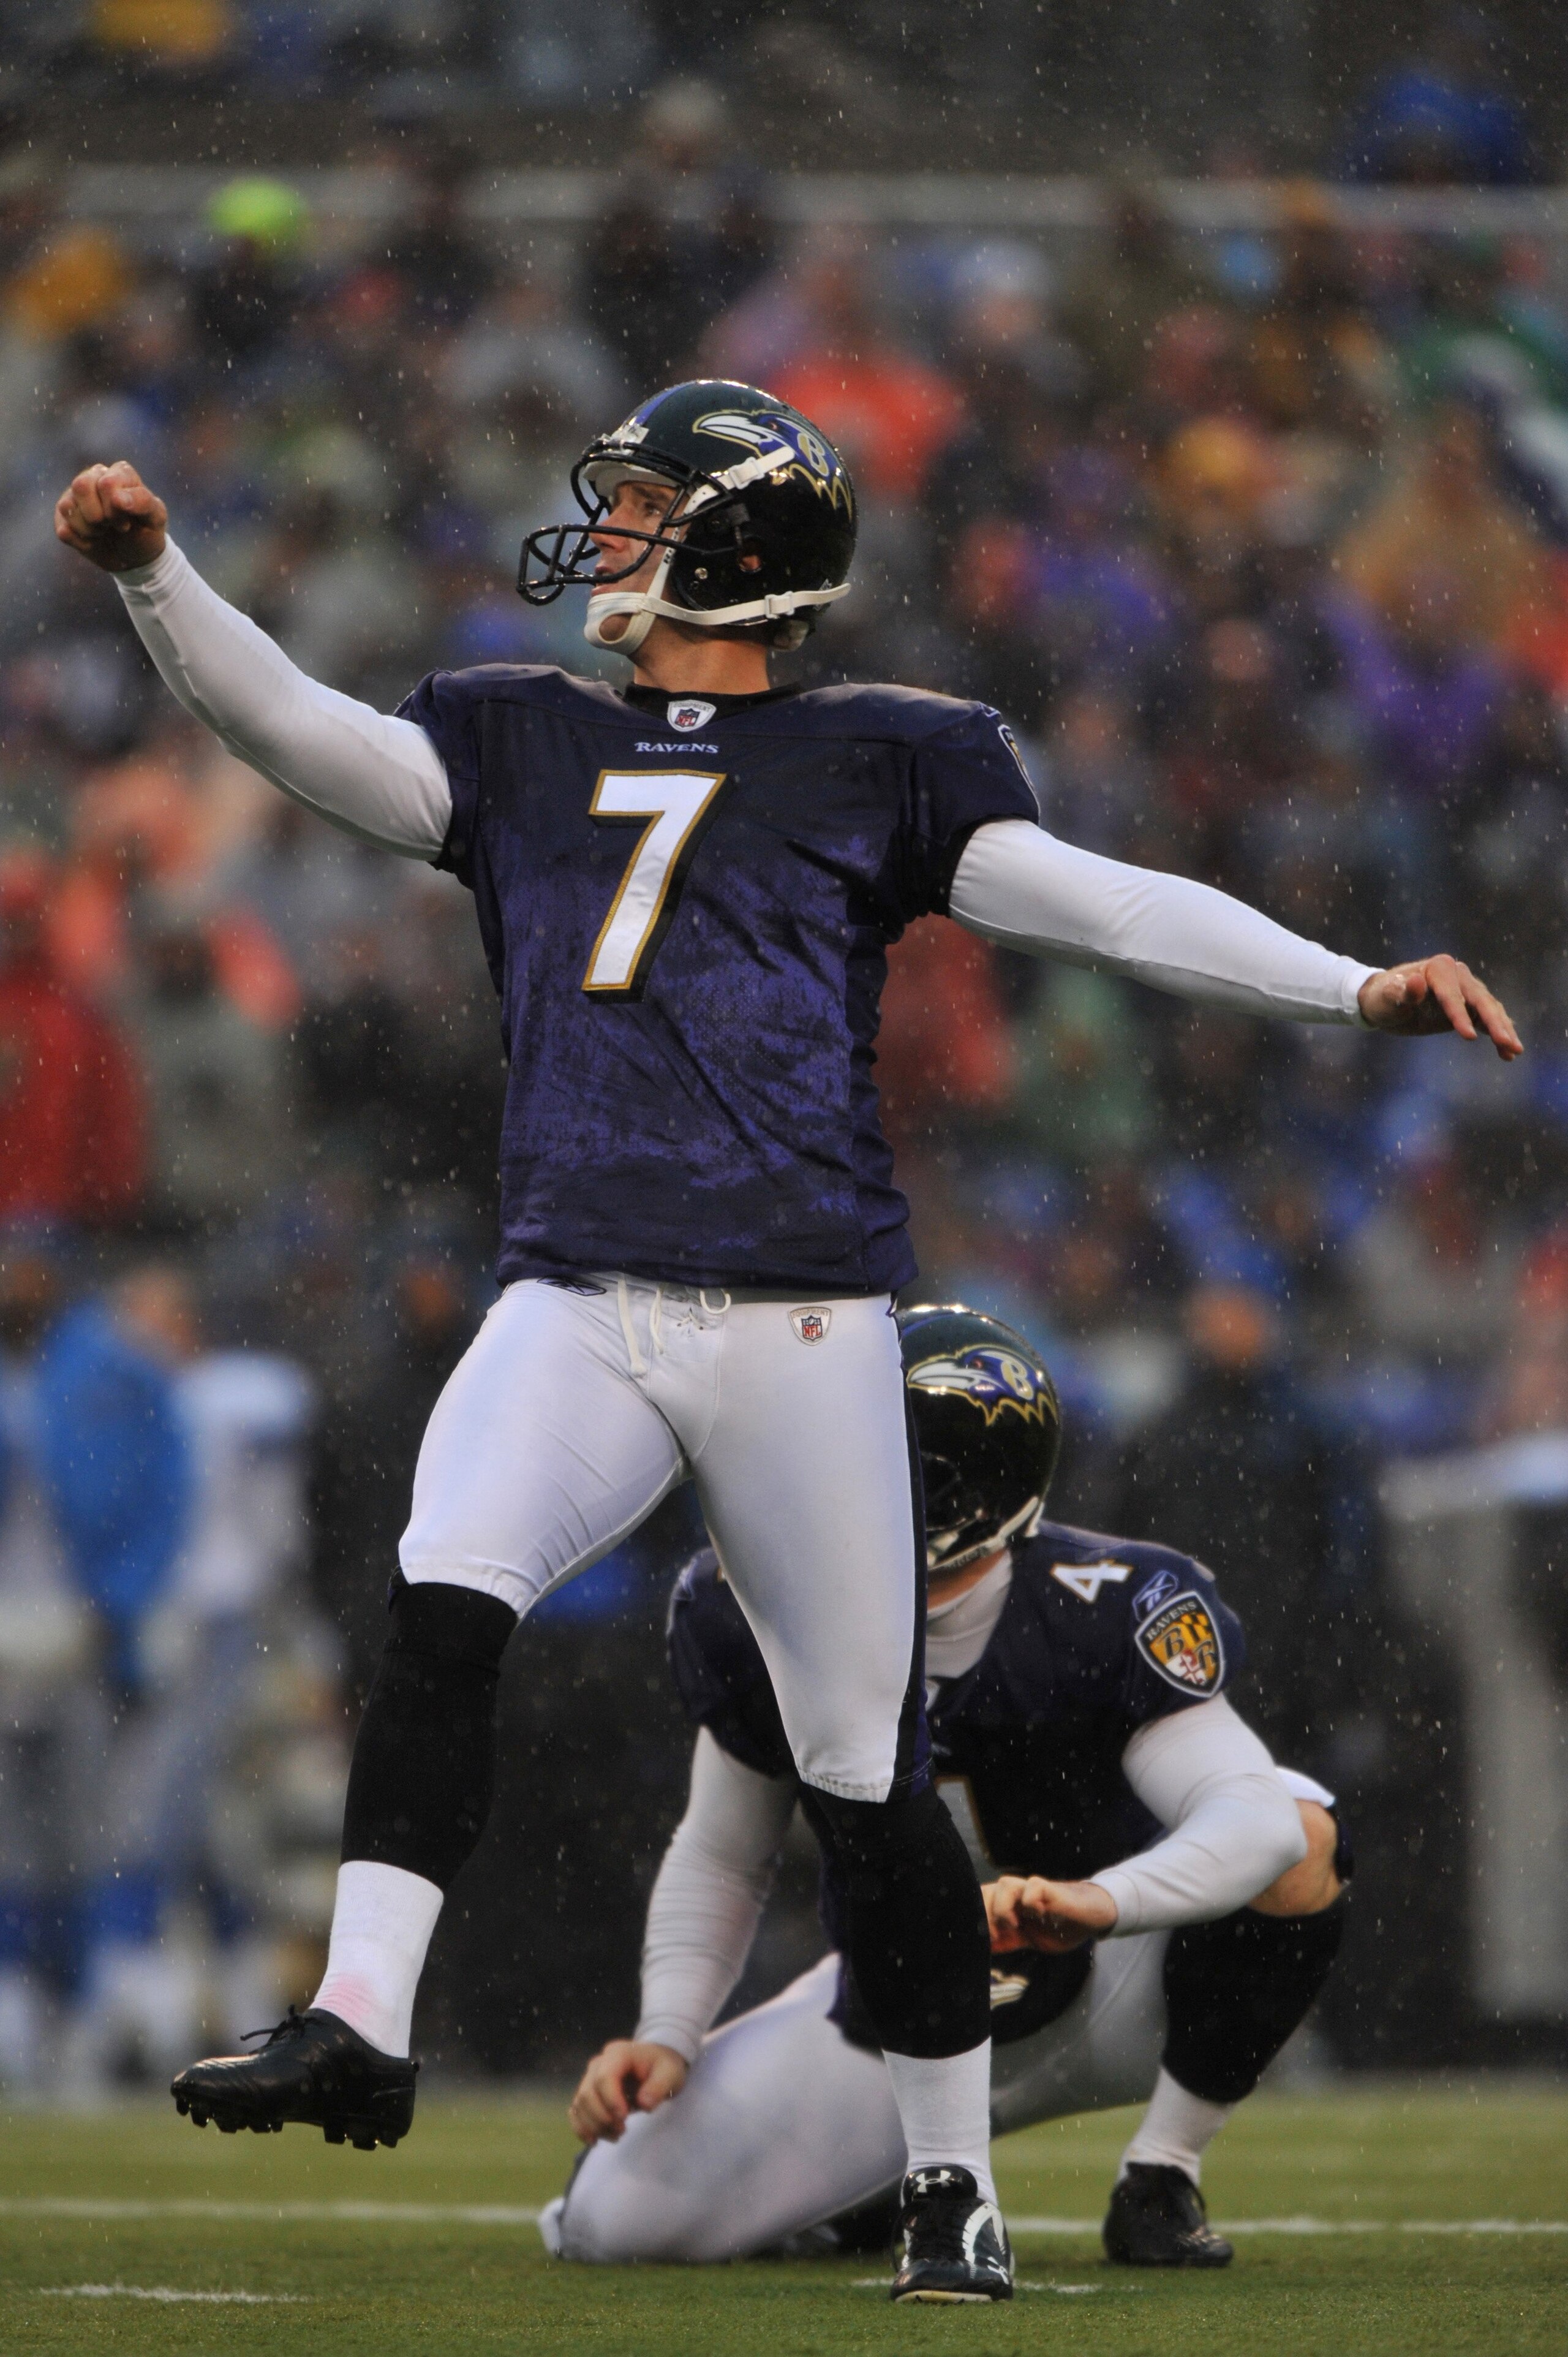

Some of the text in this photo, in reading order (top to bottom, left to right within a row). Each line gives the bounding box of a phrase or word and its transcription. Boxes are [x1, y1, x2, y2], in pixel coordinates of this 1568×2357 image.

[676, 715, 696, 727] NFL
[634, 741, 720, 754] RAVENS
[581, 769, 727, 991] 7
[804, 1325, 821, 1337] NFL
[1049, 1559, 1134, 1605] 4
[1145, 1601, 1197, 1641] RAVENS
